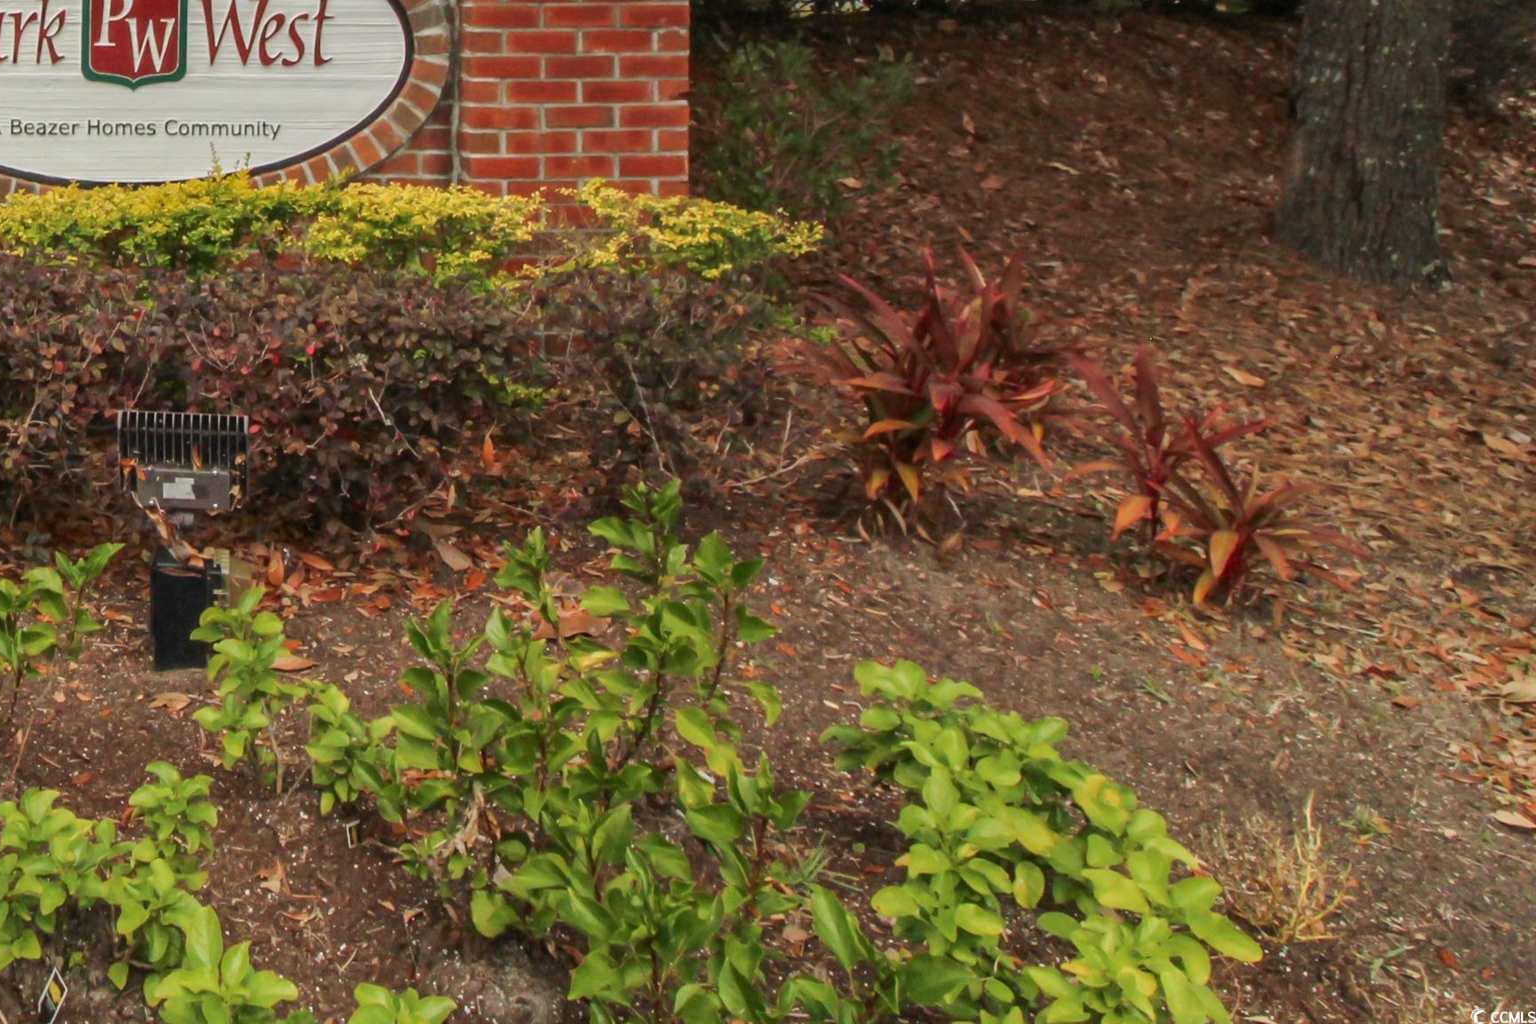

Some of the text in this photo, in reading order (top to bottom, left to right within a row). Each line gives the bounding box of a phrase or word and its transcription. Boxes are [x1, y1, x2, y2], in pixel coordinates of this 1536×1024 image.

[10, 119, 80, 136] Beazer
[87, 119, 156, 136] Homes
[165, 119, 281, 141] Community
